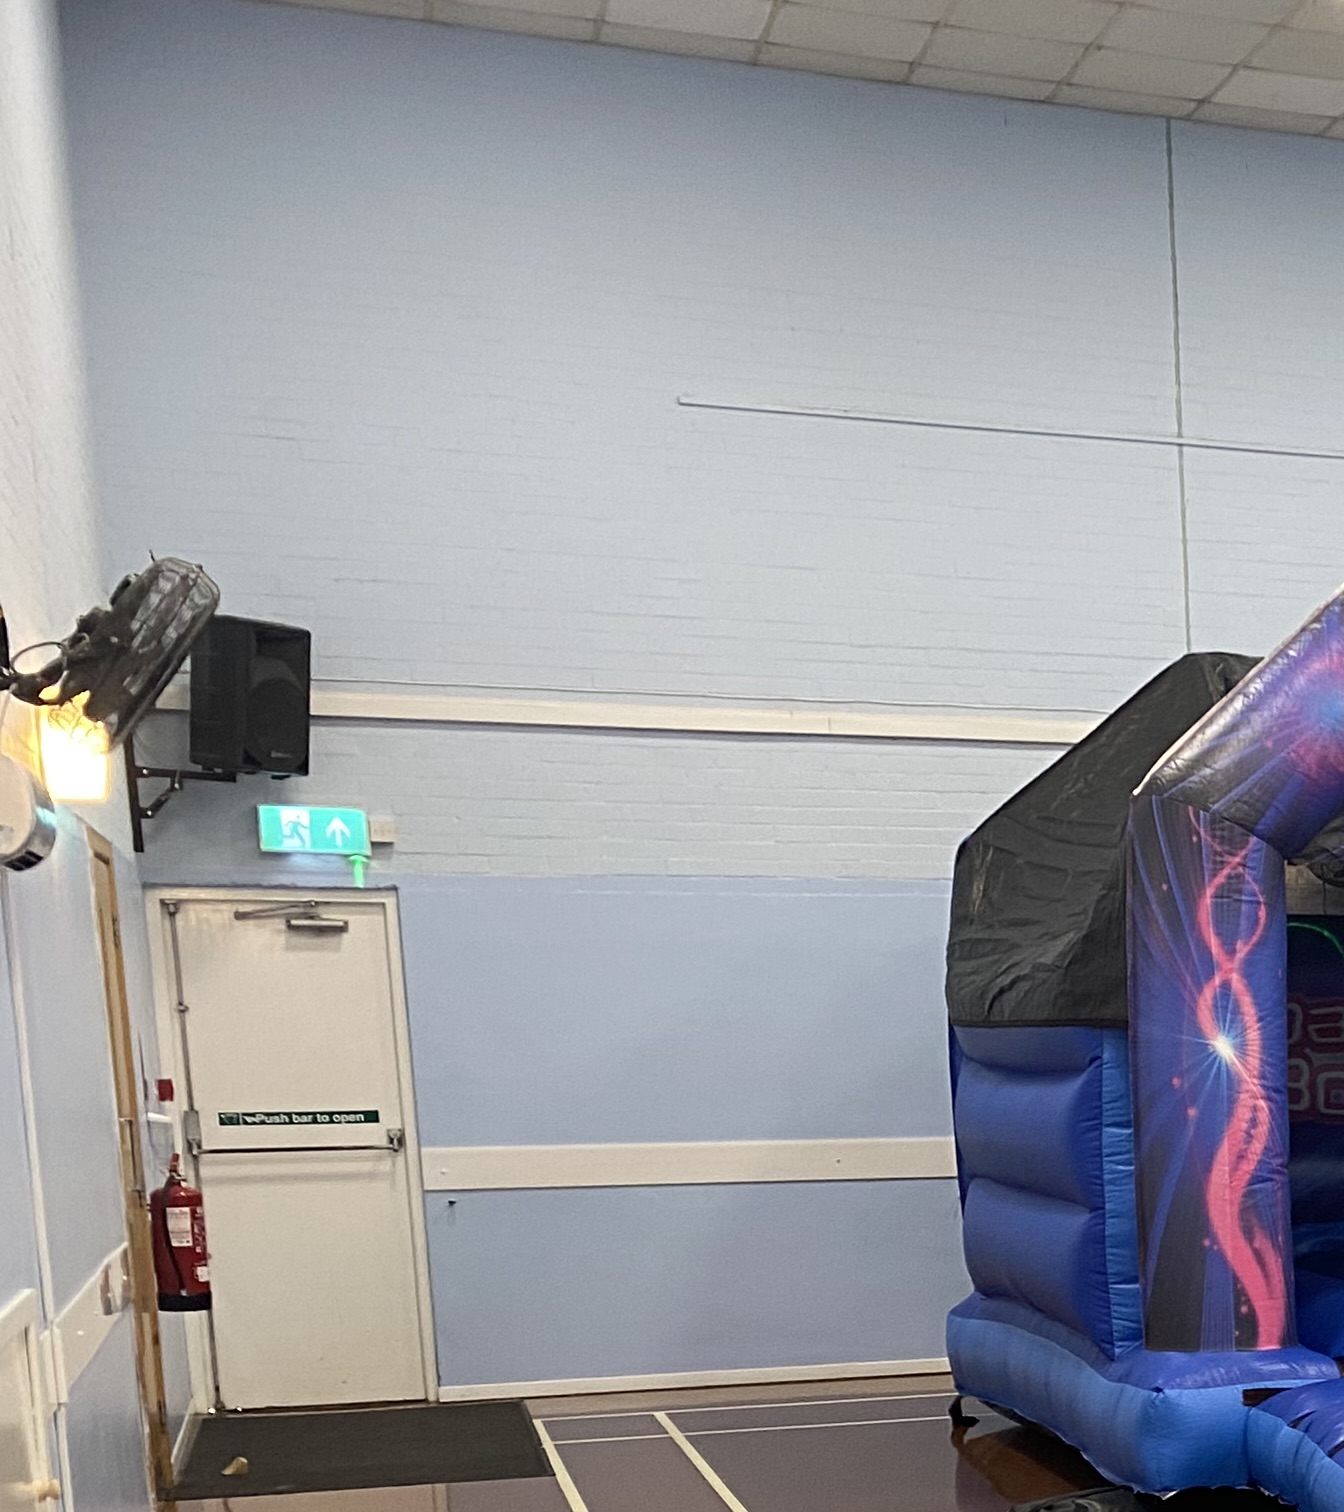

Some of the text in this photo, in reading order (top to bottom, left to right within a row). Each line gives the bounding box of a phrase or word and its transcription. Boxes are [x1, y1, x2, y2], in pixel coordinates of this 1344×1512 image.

[255, 1113, 365, 1125] Push bar to open
